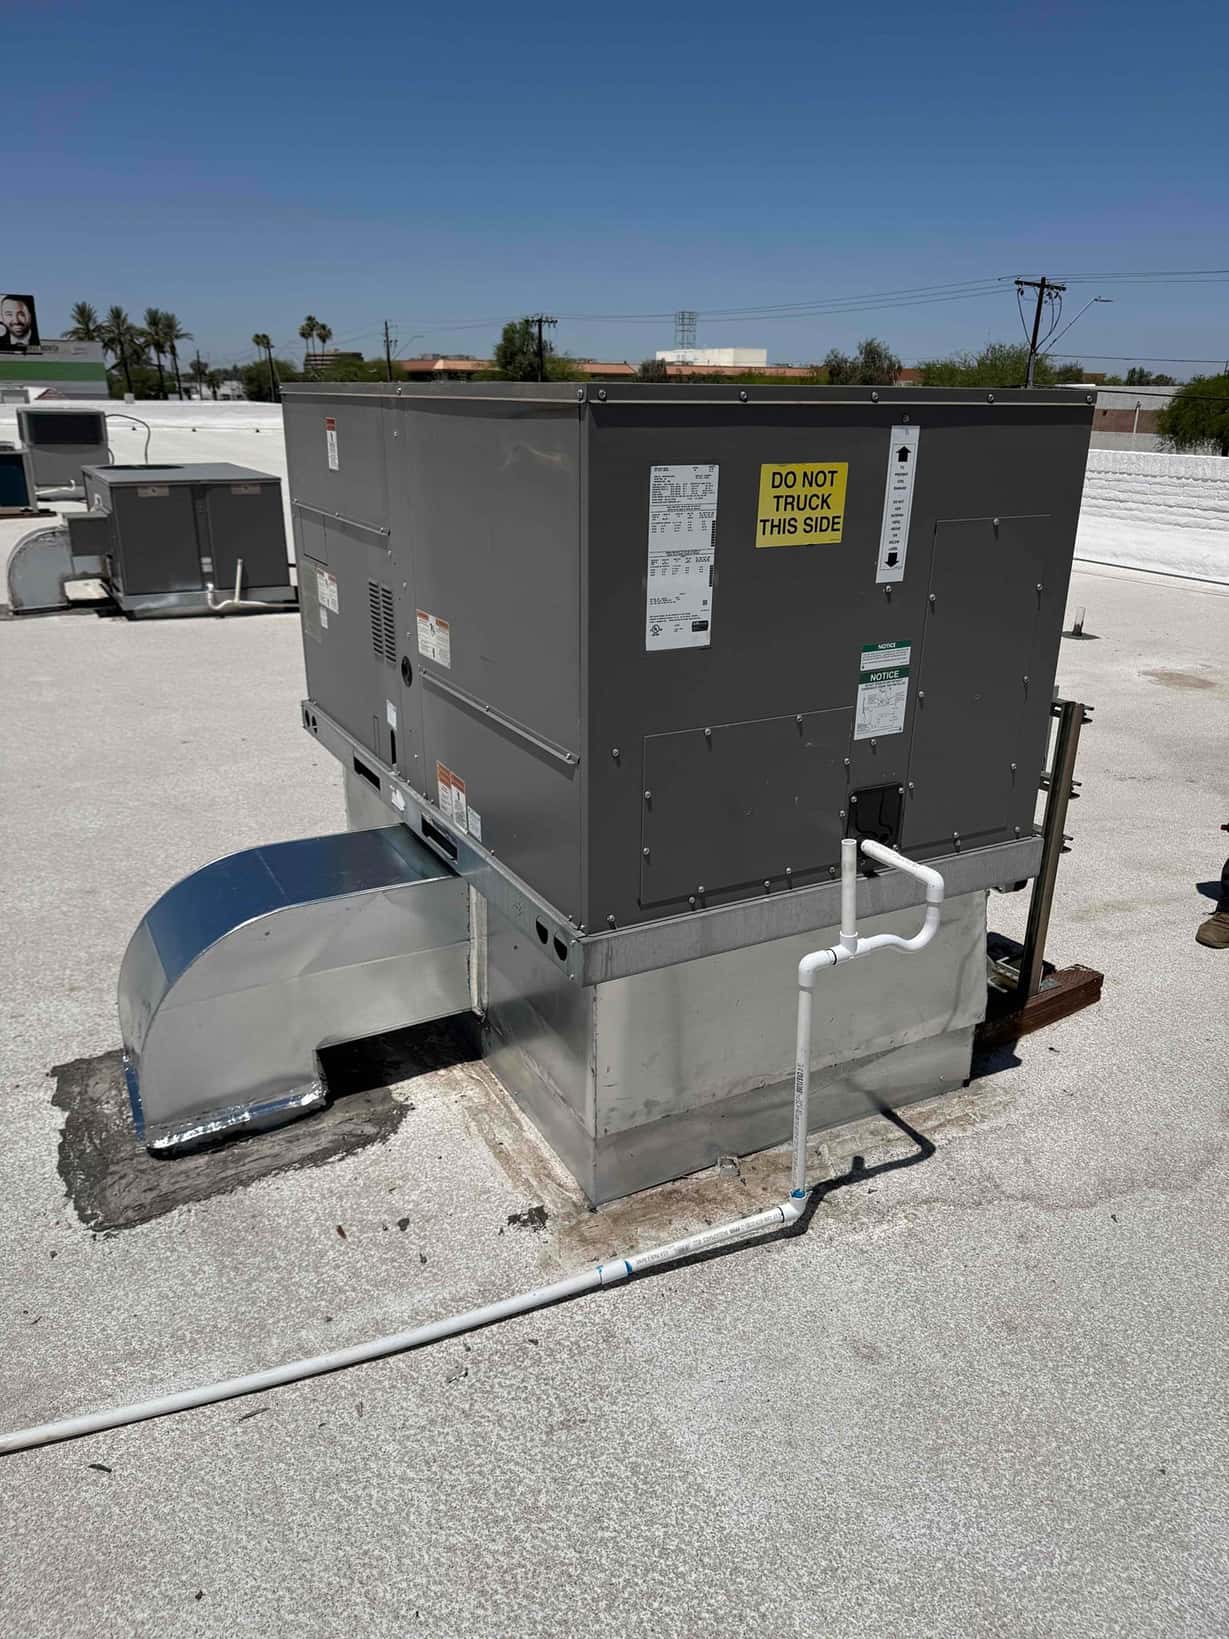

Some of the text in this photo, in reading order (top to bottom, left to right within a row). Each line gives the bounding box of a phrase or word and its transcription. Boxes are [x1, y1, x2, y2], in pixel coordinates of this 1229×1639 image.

[771, 470, 839, 489] DO NOT
[773, 493, 833, 512] TRUCK
[759, 515, 842, 536] THIS SIDE
[870, 670, 899, 681] NOTICE
